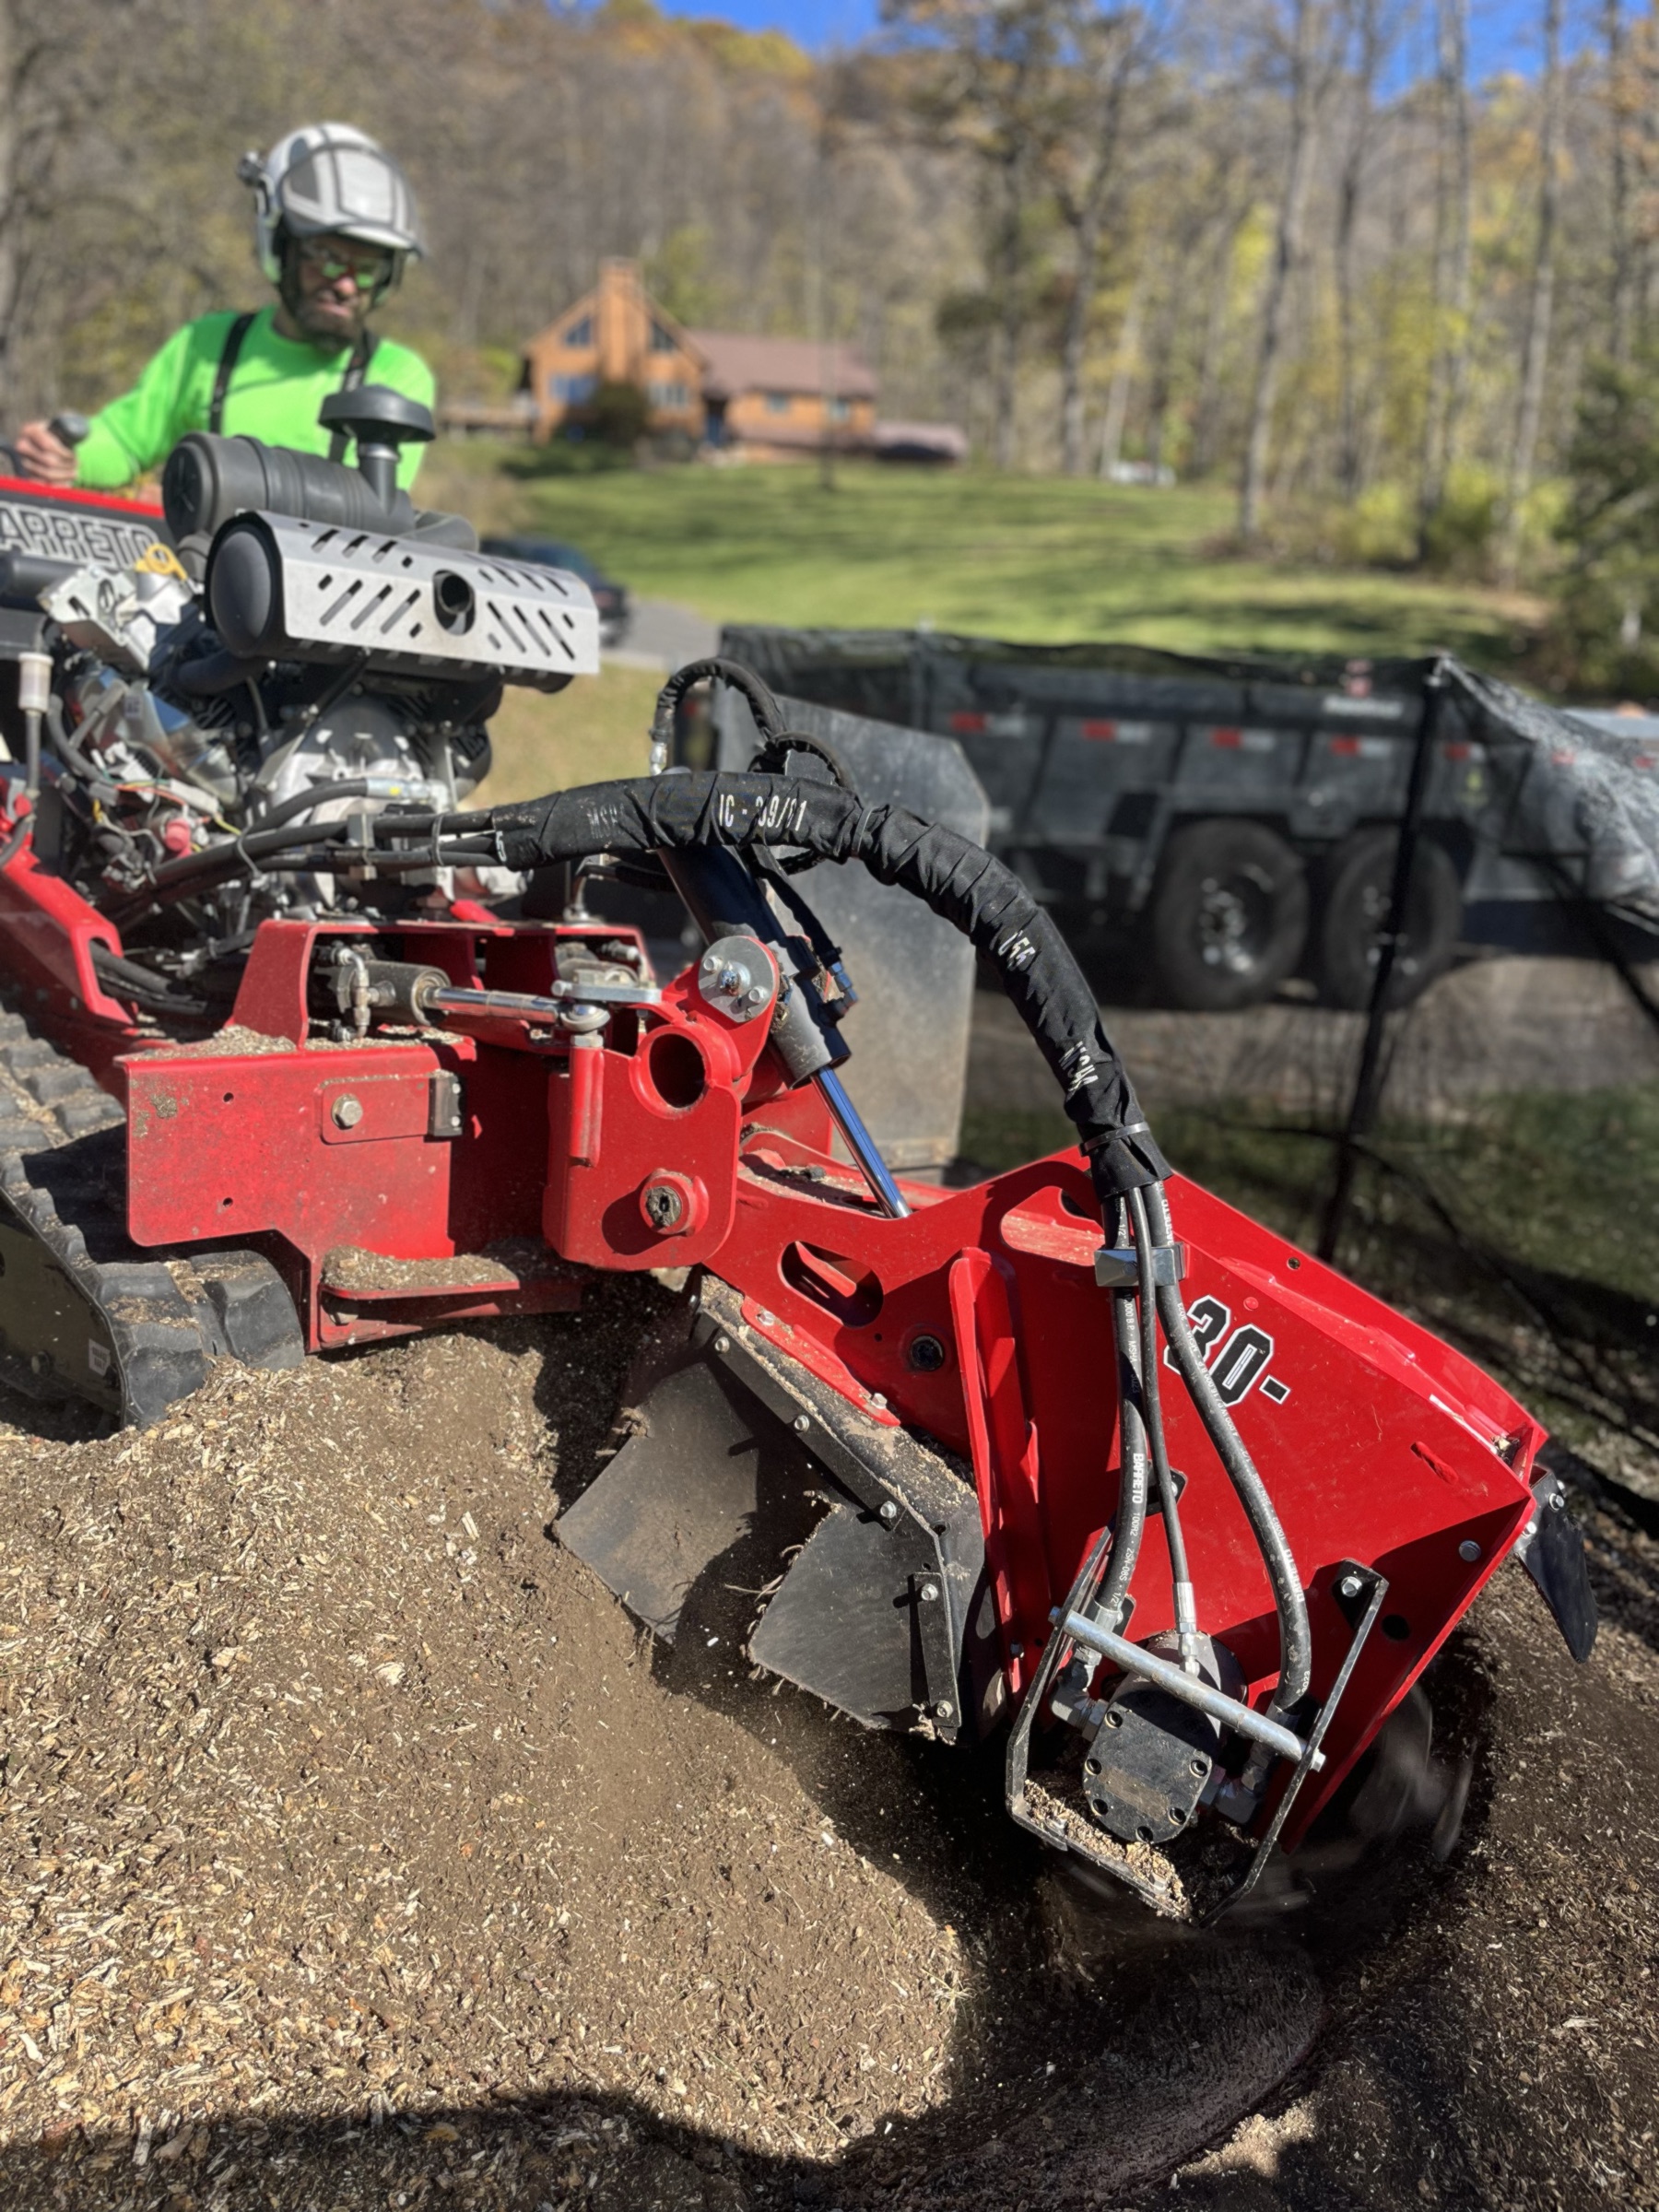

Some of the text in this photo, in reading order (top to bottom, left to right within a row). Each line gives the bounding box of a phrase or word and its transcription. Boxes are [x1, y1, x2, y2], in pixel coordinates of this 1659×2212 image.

[1128, 1340, 1138, 1362] MSHA
[1132, 1453, 1145, 1504] BARRETO
[1129, 1512, 1141, 1536] 100R2
[1119, 1547, 1135, 1582] 2SN-08S
